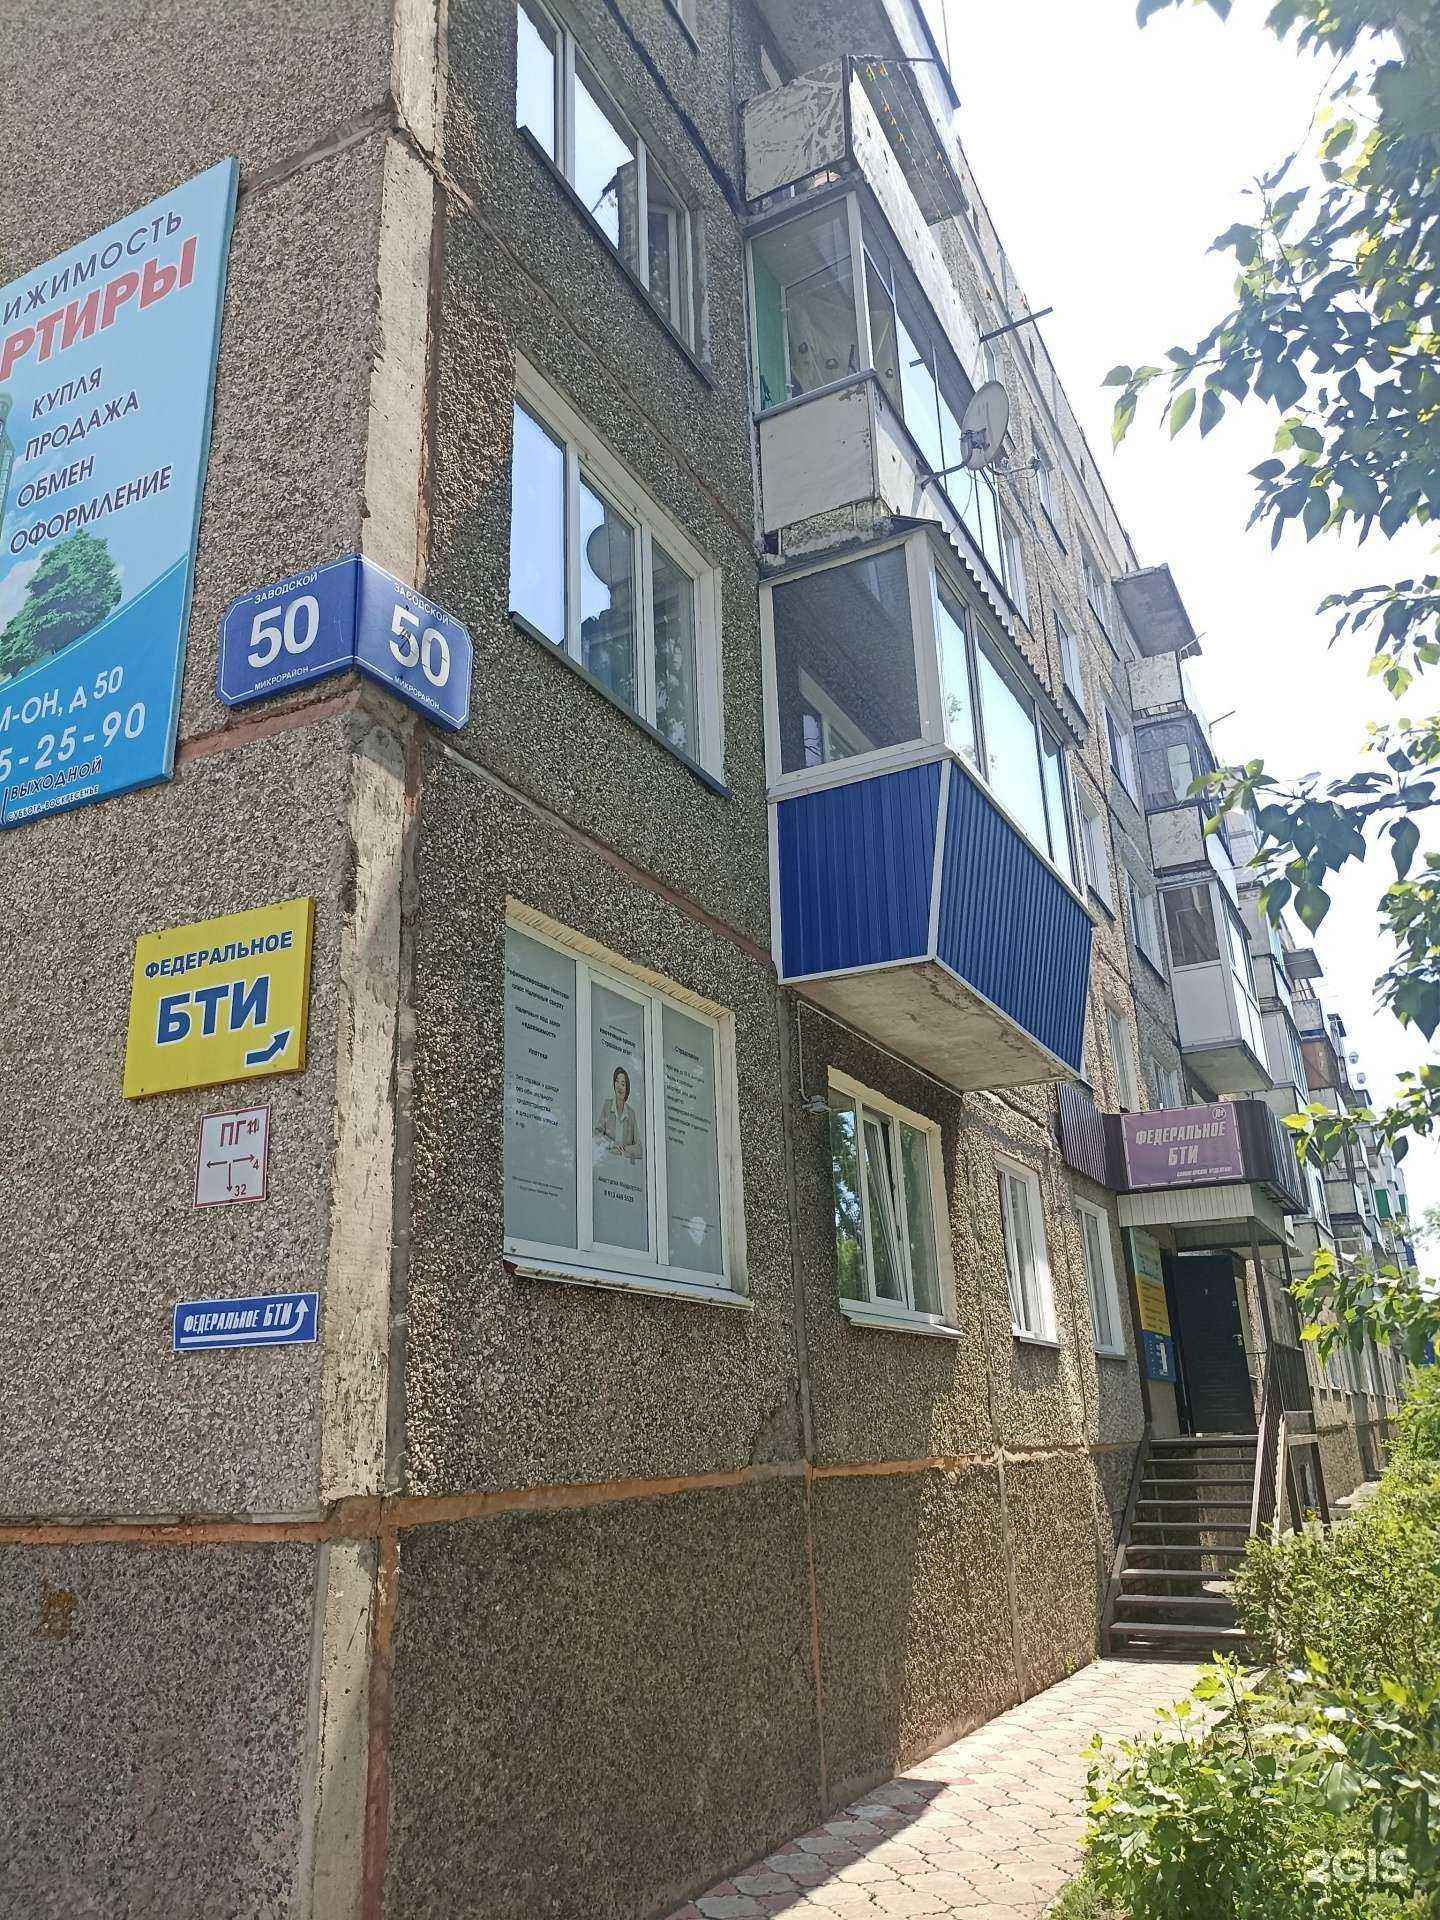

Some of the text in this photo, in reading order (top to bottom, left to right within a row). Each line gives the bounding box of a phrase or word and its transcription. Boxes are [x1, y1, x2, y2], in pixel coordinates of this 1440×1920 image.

[31, 367, 103, 420] КУПЛЯ
[24, 390, 140, 462] ПРОДАЖА
[18, 455, 95, 507] ОБМЕН
[10, 465, 172, 554] ОФОРМЛЕНИЕ
[253, 571, 319, 604] ЗАВОДСКОЙ
[392, 583, 450, 625] ЗАВОДСКОЙ
[247, 595, 320, 669] 50
[389, 604, 451, 687] 50
[68, 686, 87, 714] А
[93, 665, 124, 700] 50
[254, 666, 309, 691] МИКРОРАЙОН
[394, 675, 440, 710] МИКРОРАЙОН
[9, 755, 103, 801] ВЫХОДНОЙ
[145, 930, 293, 978] ФЕДЕРАЛЬНОЕ
[157, 976, 270, 1045] БТИ
[1135, 1121, 1227, 1146] ФЕДЕРАЛЬНОЕ
[1168, 1145, 1199, 1166] БТИ
[234, 1183, 247, 1197] 32
[183, 1302, 293, 1334] ФЕДЕРАЛЬНОЕ БТИ
